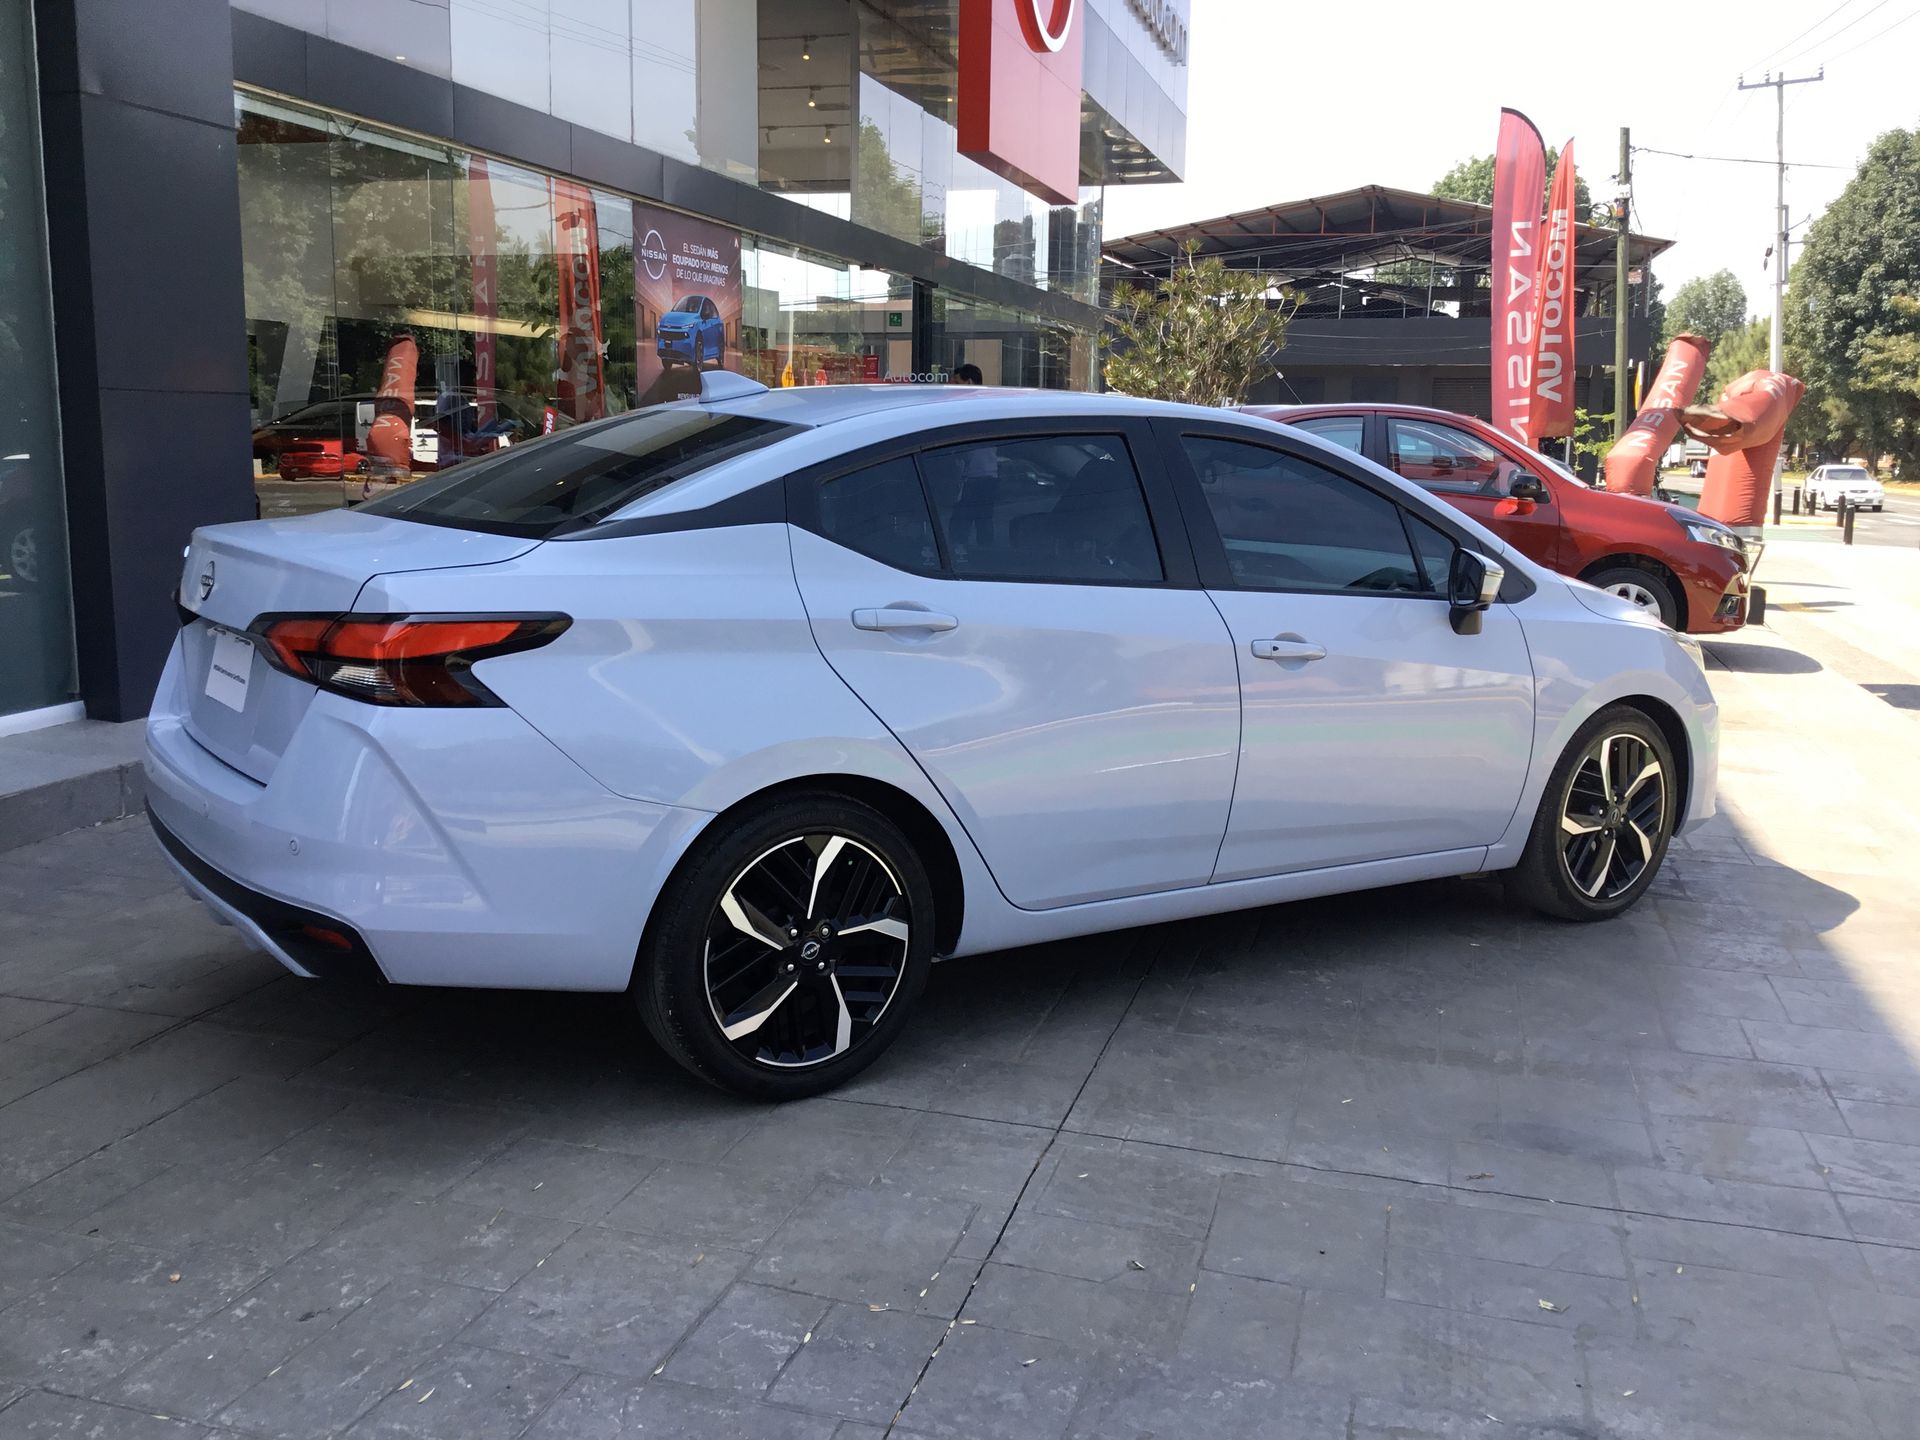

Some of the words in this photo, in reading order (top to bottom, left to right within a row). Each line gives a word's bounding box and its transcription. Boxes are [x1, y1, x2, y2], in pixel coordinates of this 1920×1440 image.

[641, 248, 668, 261] NISSAN
[683, 243, 690, 253] EL
[690, 244, 706, 257] SEDÁN
[706, 247, 719, 260] MÁS
[672, 254, 700, 268] EQUIPADO
[700, 259, 711, 271] POR
[711, 261, 729, 275] MENOS
[676, 269, 684, 278] DE
[684, 270, 691, 280] LO
[692, 271, 702, 282] QUE
[702, 273, 726, 287] IMAGINAS
[1536, 209, 1568, 403] AUTOCOM
[883, 370, 949, 383] Autocom
[1628, 361, 1688, 447] NISSAN
